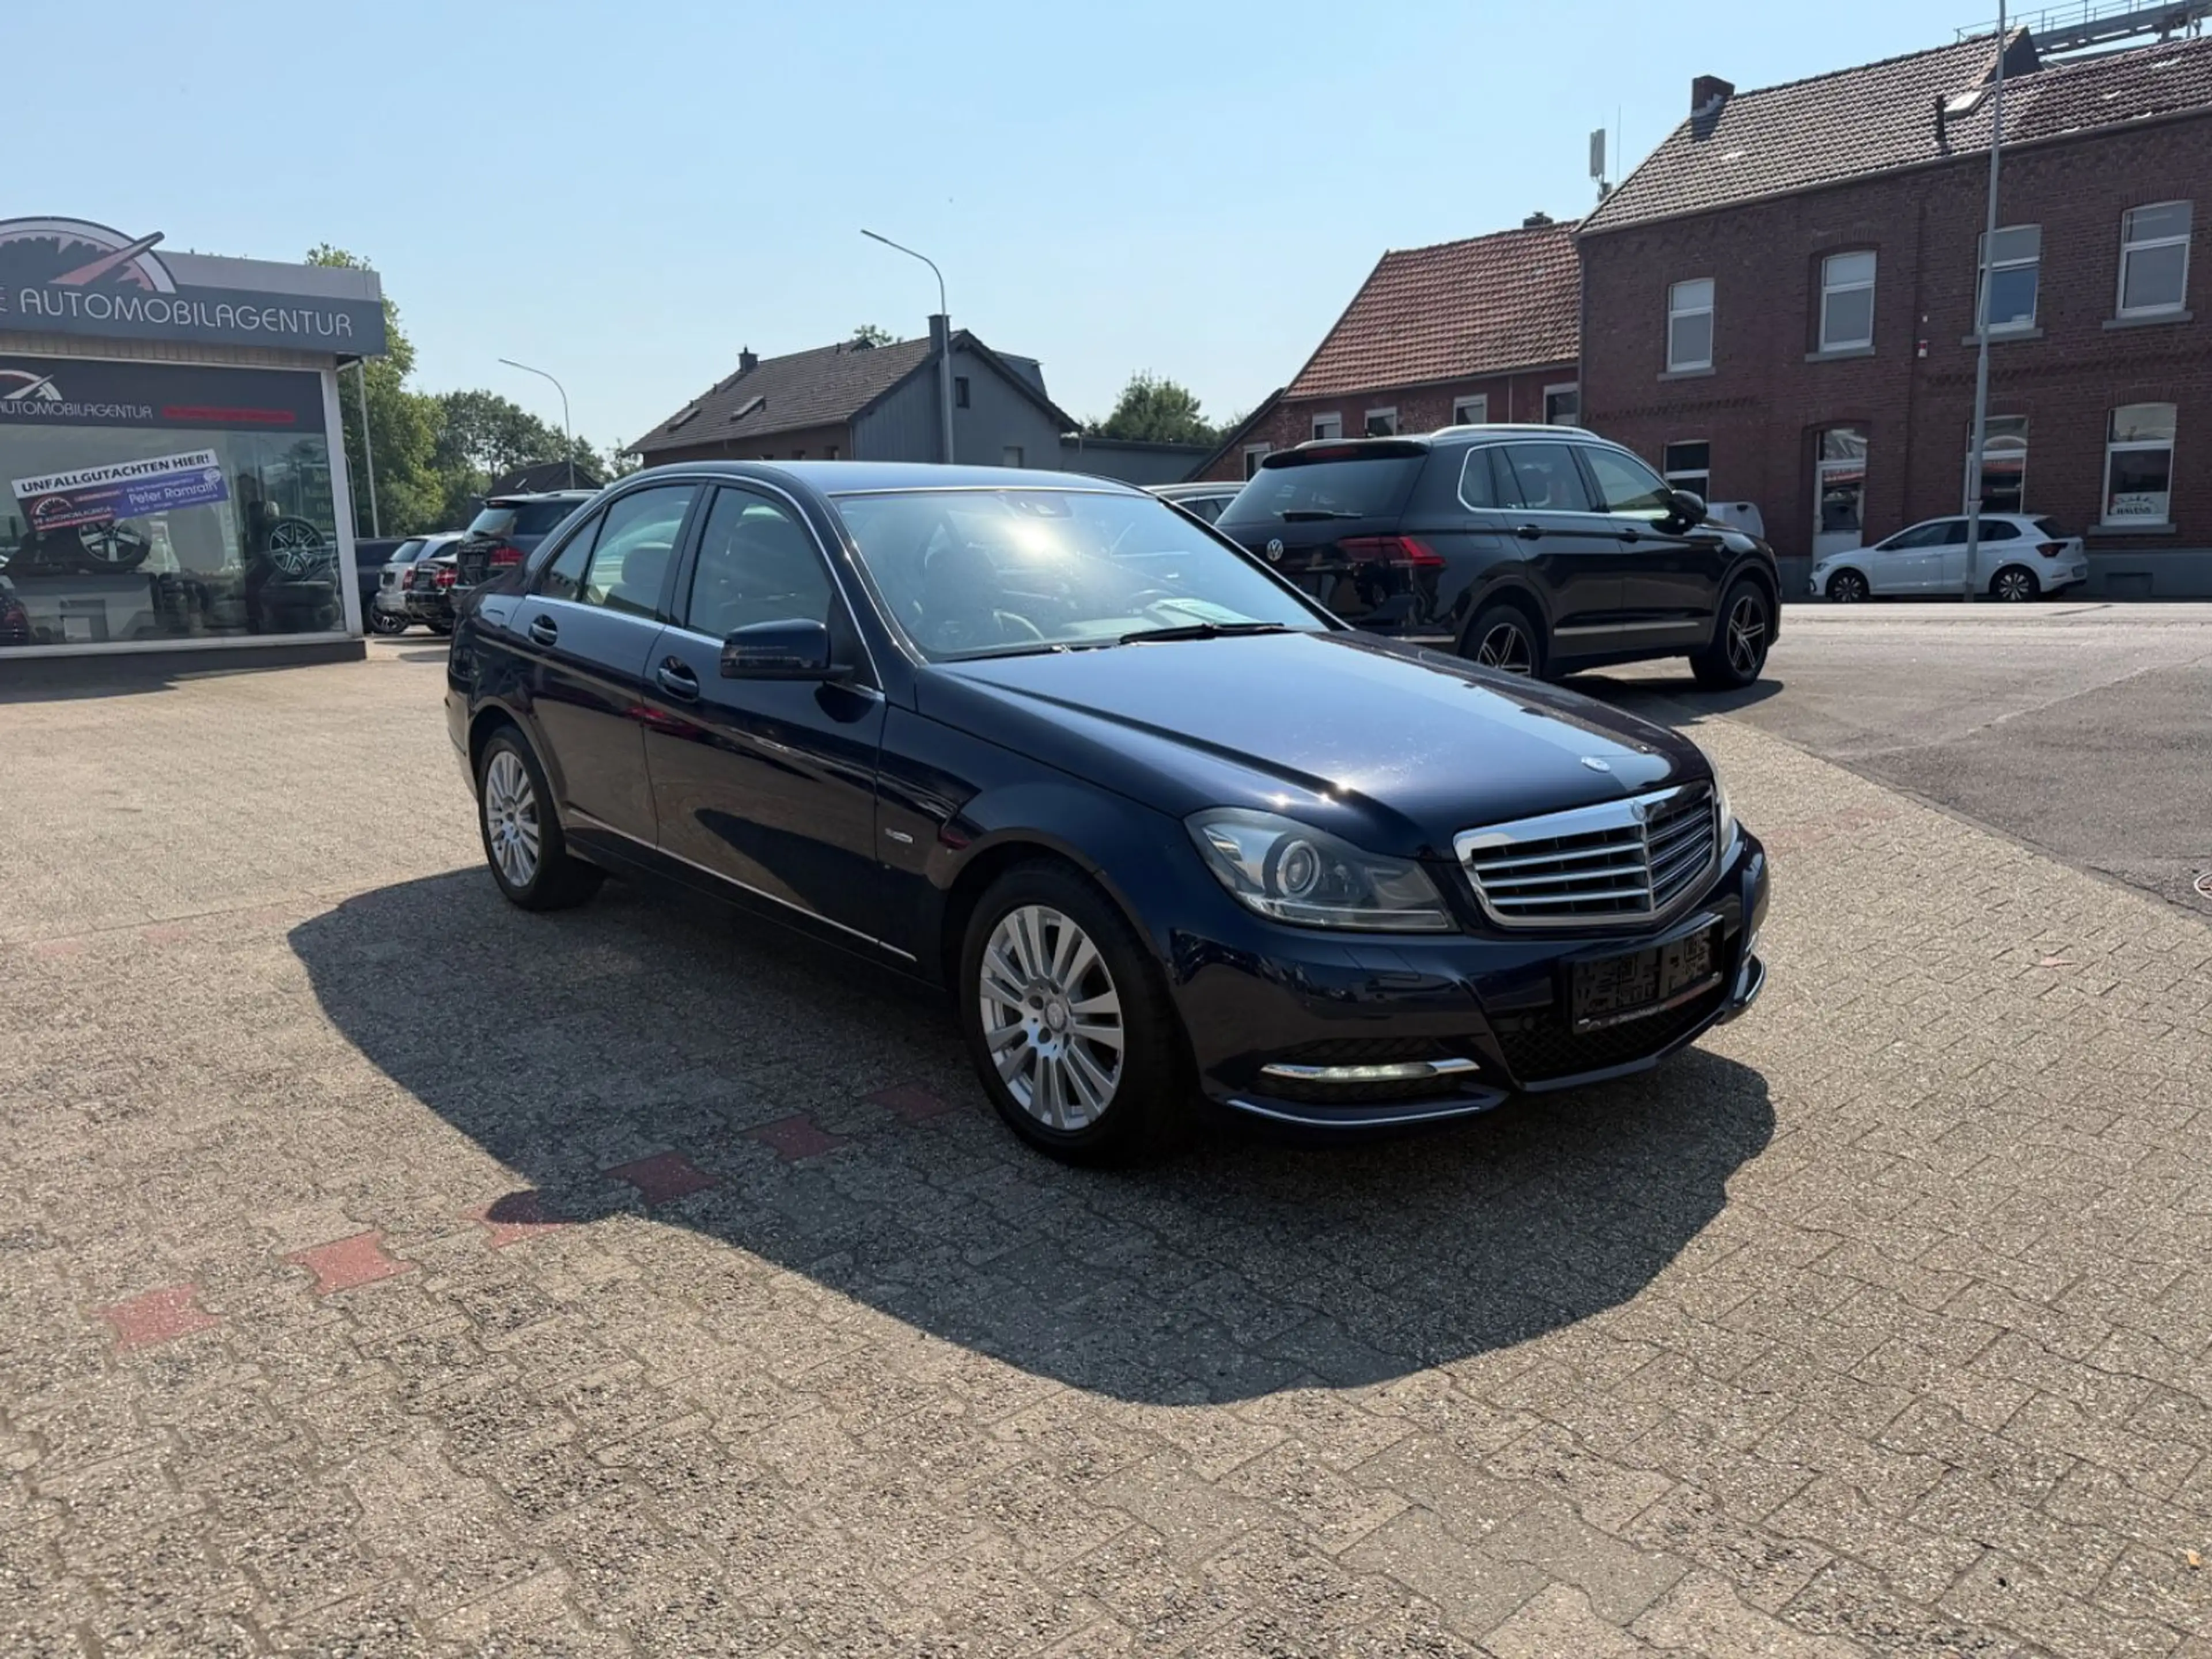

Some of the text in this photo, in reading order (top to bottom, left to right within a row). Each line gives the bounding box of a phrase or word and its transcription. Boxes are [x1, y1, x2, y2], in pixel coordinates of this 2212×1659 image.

[20, 288, 352, 337] AUTOMOBILAGENTUR
[21, 460, 170, 493] UNFALLGUTACHTEN
[172, 453, 209, 468] HIER!
